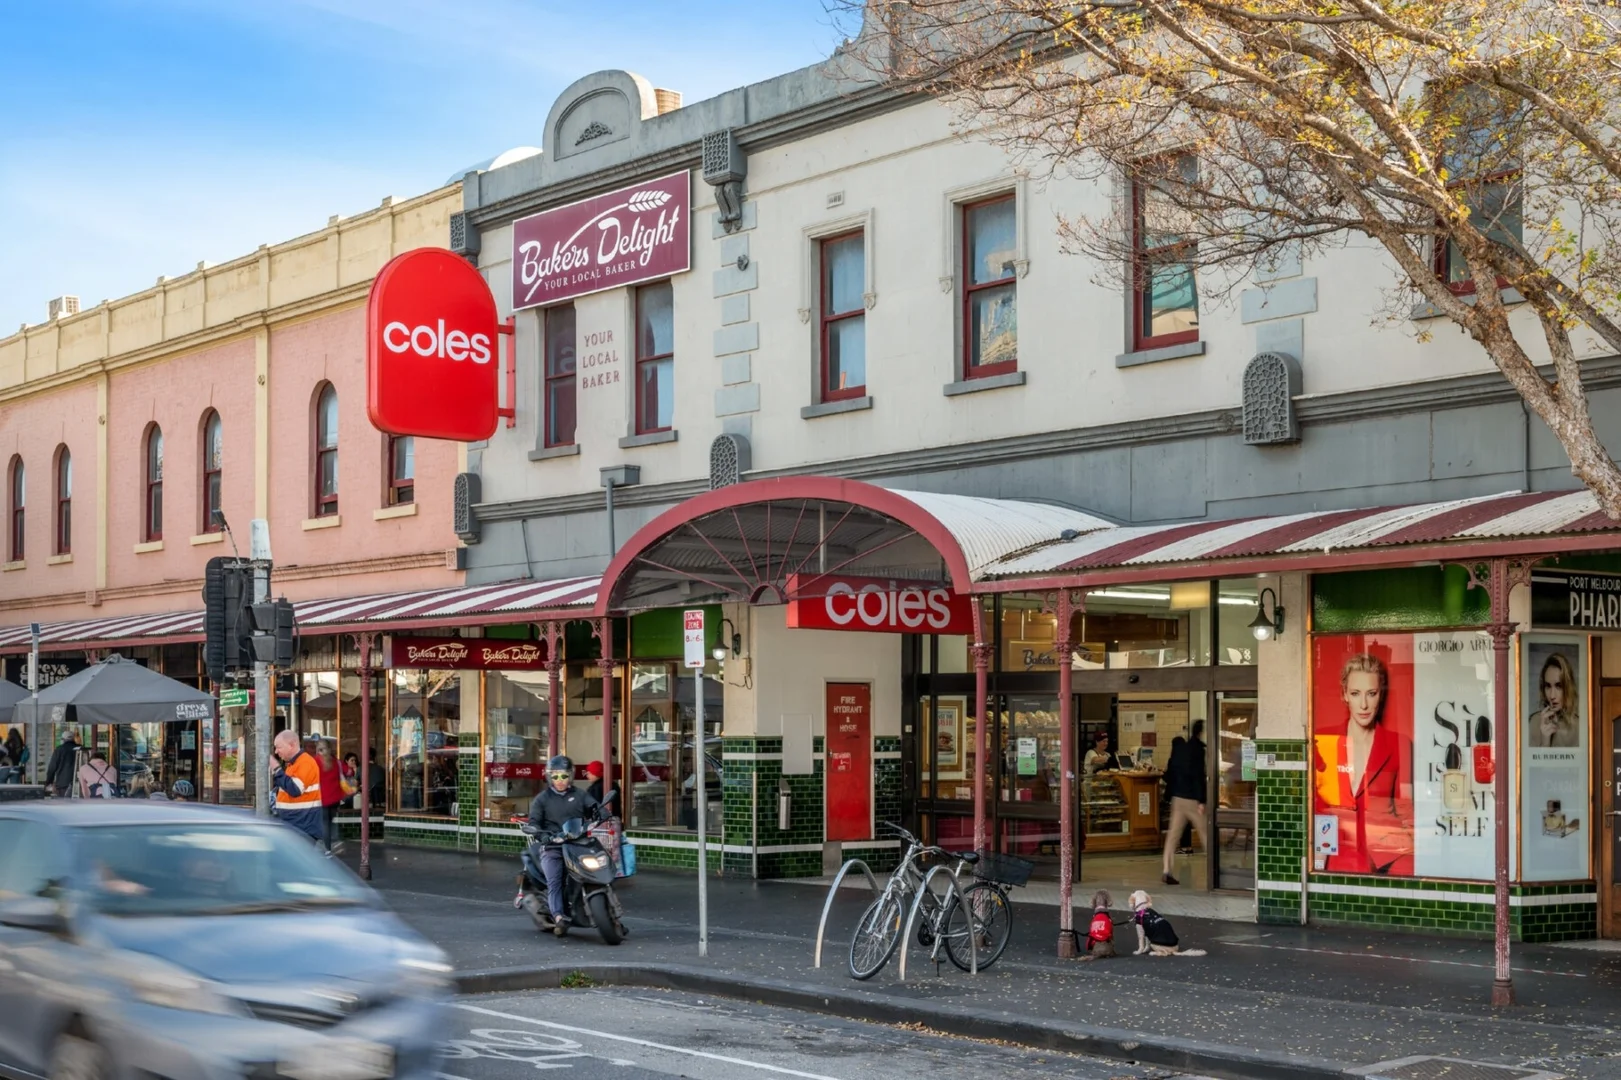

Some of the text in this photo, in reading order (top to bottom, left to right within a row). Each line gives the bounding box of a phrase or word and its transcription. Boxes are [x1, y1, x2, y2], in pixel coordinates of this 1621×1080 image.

[518, 205, 679, 285] Bakers Delight
[545, 260, 636, 291] YOUR LOCAL BAKER
[383, 318, 491, 364] coles
[584, 330, 613, 347] YOUR
[583, 350, 618, 368] LOCAL
[583, 370, 620, 389] BAKER
[1569, 576, 1589, 589] PORT
[825, 580, 951, 629] coles
[1569, 591, 1621, 628] PHAR
[407, 646, 468, 662] Bakers Delight
[1418, 638, 1493, 653] GIORGIO ARM
[482, 648, 540, 663] Bakers Delight
[840, 696, 856, 705] FIRE
[833, 705, 863, 714] HYDRANT
[839, 724, 857, 733] HOSE
[1435, 815, 1489, 837] SELF
